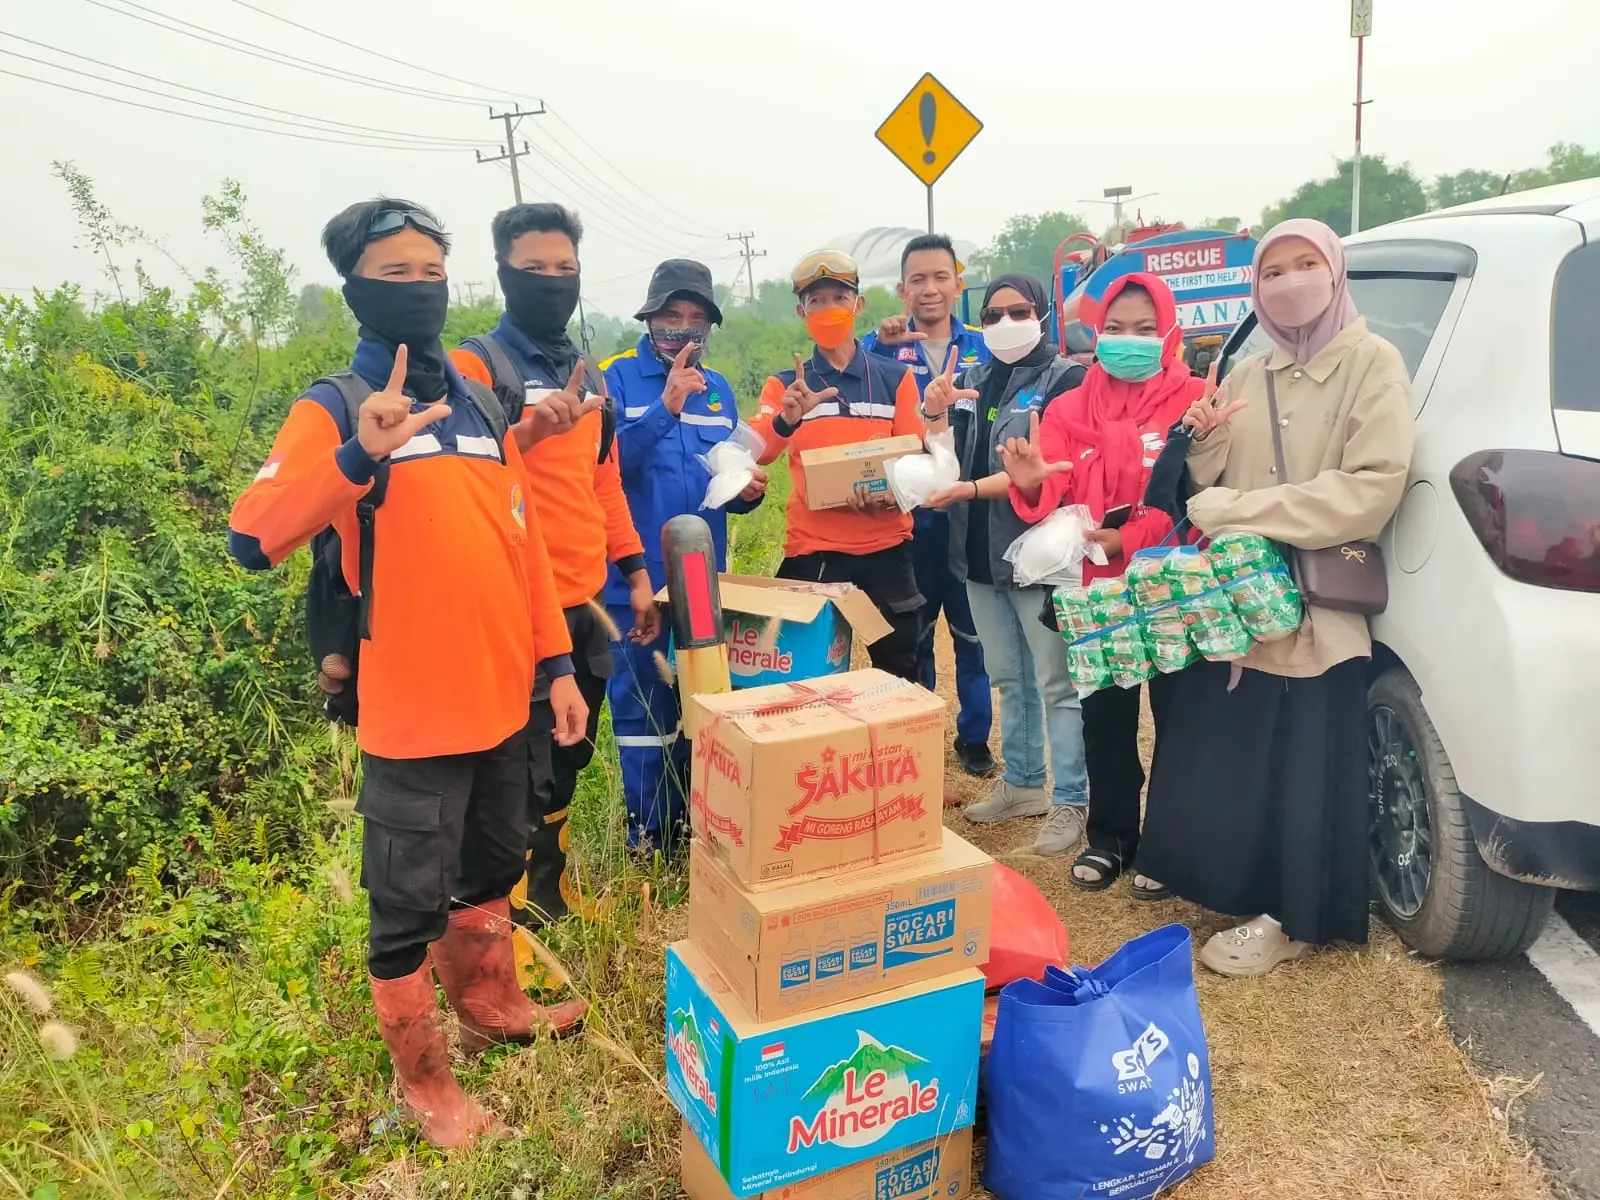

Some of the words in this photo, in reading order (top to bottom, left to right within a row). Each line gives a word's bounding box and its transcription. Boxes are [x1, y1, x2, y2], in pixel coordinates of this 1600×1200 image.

[1147, 248, 1221, 272] RESCUE
[1166, 278, 1180, 288] THE
[1182, 275, 1203, 287] FIRST
[1206, 274, 1215, 284] TO
[1217, 271, 1237, 282] HELP
[733, 620, 758, 646] Le
[728, 647, 792, 672] nerale
[852, 748, 867, 761] mi
[804, 822, 815, 834] MI
[817, 822, 853, 835] GORENG
[854, 814, 876, 831] RASA
[879, 803, 901, 821] AYAM
[887, 908, 954, 936] POCARI
[886, 922, 947, 949] SWEAT
[684, 1021, 698, 1064] Le
[668, 1022, 717, 1117] Minerale
[744, 1074, 763, 1083] milik
[764, 1064, 799, 1078] Indonesia
[755, 1062, 776, 1072] 100%
[776, 1057, 790, 1066] Asli
[844, 1070, 886, 1107] Le
[788, 1083, 939, 1152] Minerale
[742, 1168, 779, 1184] Sehatnya
[742, 1177, 772, 1191] Mineral
[774, 1162, 818, 1181] Terlindungi
[1138, 1160, 1173, 1178] NYAMAN
[1109, 1172, 1164, 1196] BERKUALITAS
